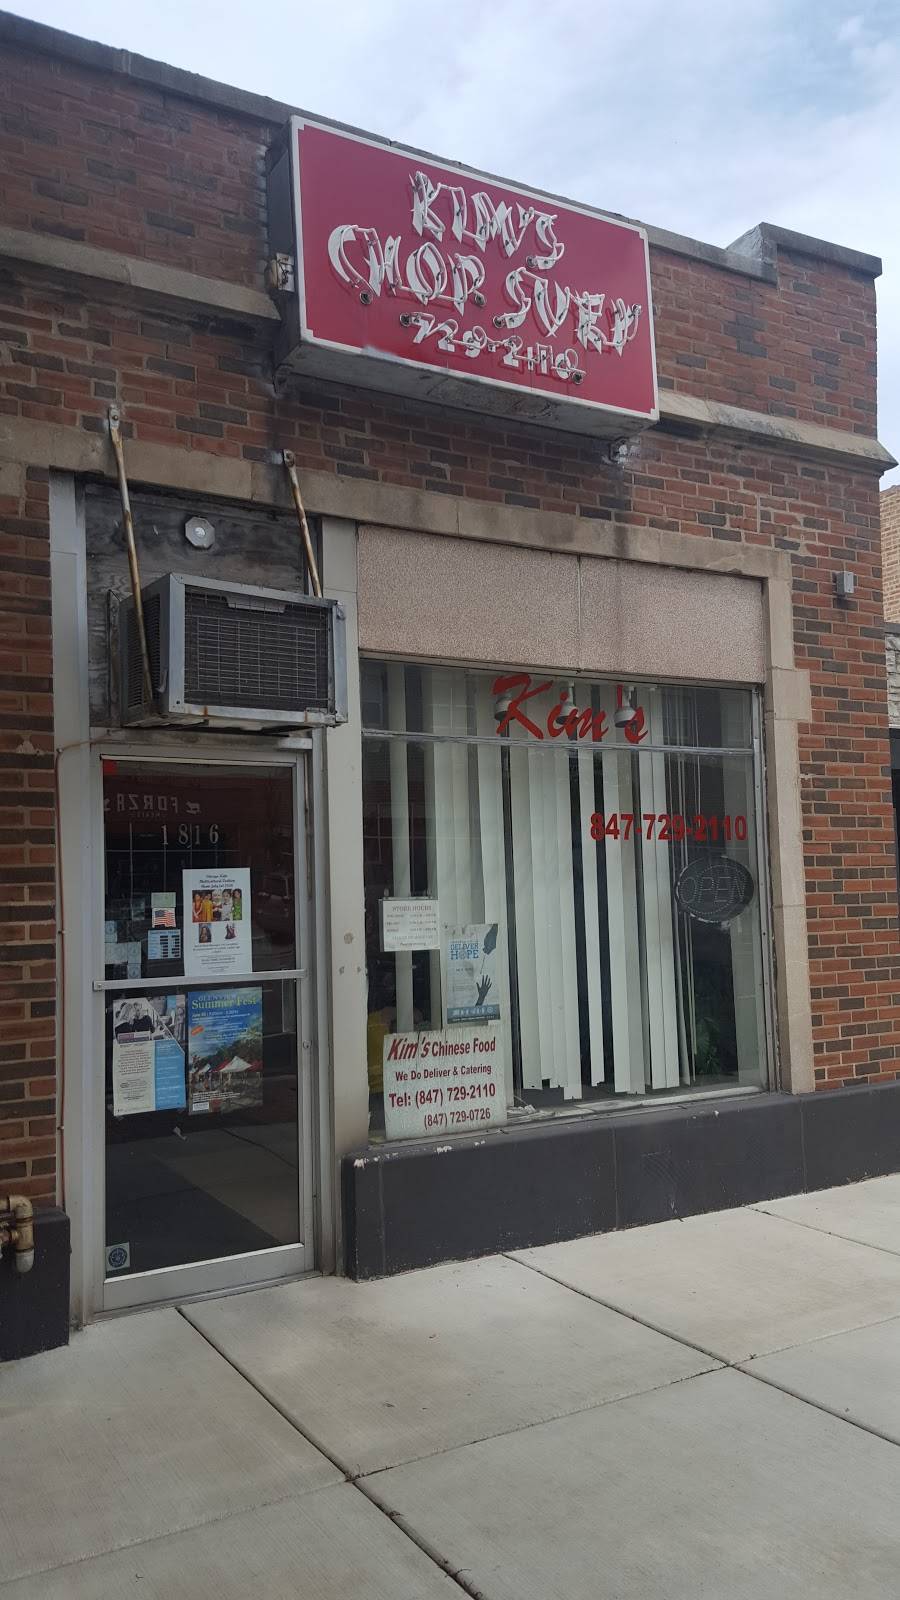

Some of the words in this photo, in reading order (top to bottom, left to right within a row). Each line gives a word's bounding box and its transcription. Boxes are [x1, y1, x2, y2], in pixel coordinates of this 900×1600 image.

[327, 224, 486, 317] CHOP
[502, 267, 642, 357] SUEY
[409, 311, 586, 380] 729-2110
[492, 674, 648, 744] Kim's
[160, 823, 220, 846] 1816
[589, 812, 750, 842] 847-729-2110
[680, 876, 746, 903] OPEN
[450, 942, 479, 951] DELIVER
[450, 949, 480, 961] HOPE
[191, 998, 235, 1010] Summer
[387, 1036, 431, 1061] Kim's
[431, 1039, 471, 1058] Chinese
[473, 1036, 496, 1054] Food
[395, 1070, 408, 1082] We
[411, 1069, 421, 1080] Do
[423, 1066, 451, 1079] Deliver
[452, 1065, 459, 1076] &
[460, 1063, 492, 1076] Catering
[388, 1092, 411, 1108] Tel:
[415, 1087, 444, 1110] (847)
[447, 1082, 496, 1102] 729-2110
[423, 1111, 448, 1131] (847)
[450, 1107, 491, 1124] 729-0726
